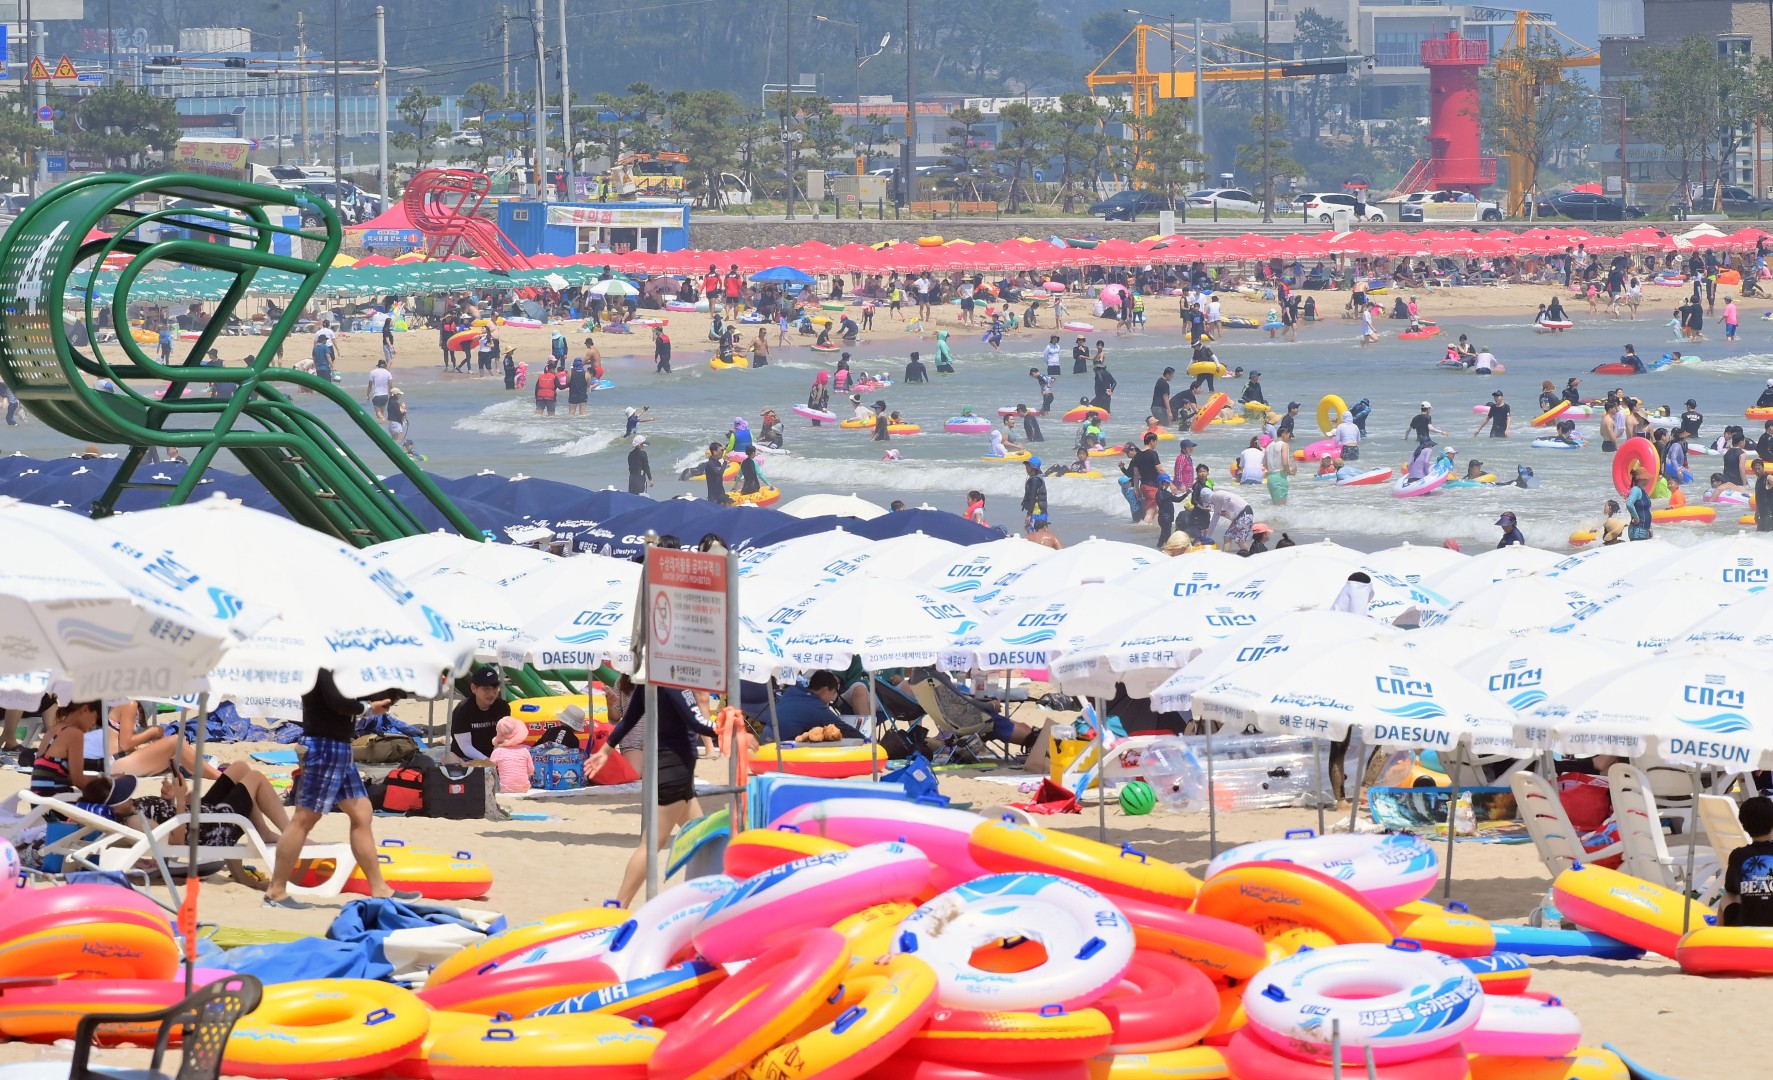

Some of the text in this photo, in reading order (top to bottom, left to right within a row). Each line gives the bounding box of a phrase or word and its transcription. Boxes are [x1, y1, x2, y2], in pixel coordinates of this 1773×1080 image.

[573, 209, 613, 224] 편의점
[542, 651, 595, 665] DAESUN
[988, 651, 1046, 665] DAESUN
[1129, 650, 1174, 664] 해운대구
[360, 667, 416, 683] 해운대구
[739, 663, 755, 674] 대구
[245, 696, 303, 711] 2030부산세계박
[1279, 714, 1329, 732] 해운대구
[1375, 724, 1450, 746] DAESUN
[1671, 738, 1750, 763] DAESUN
